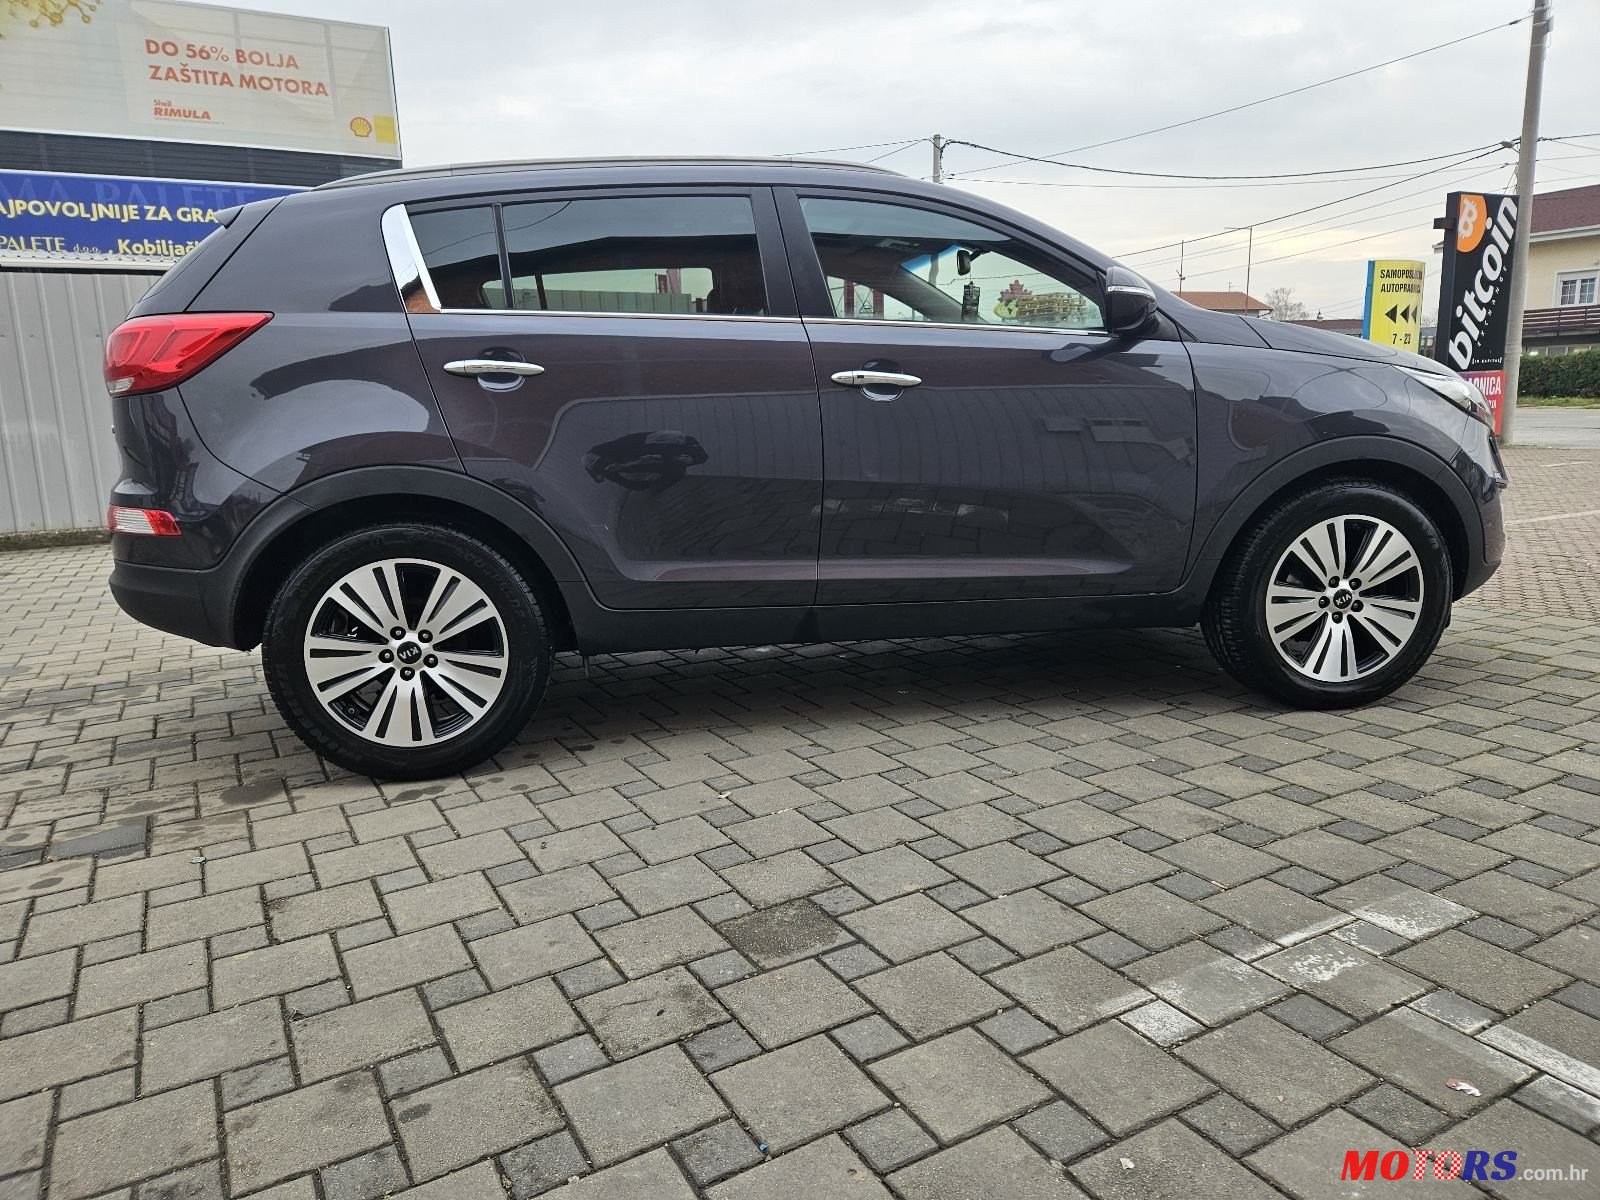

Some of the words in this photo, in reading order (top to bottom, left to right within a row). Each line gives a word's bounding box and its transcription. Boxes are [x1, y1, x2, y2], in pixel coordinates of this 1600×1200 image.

[145, 39, 178, 56] DO
[186, 44, 229, 62] 56%
[235, 49, 299, 70] BOLJA
[149, 62, 234, 87] ZAŠTITA
[239, 74, 329, 96] MOTORA
[153, 99, 172, 107] Shell
[153, 107, 211, 120] RIMULA
[144, 205, 173, 221] ZA
[1449, 197, 1518, 370] bitcoin
[1392, 333, 1398, 345] 7
[1404, 333, 1411, 345] 23
[1336, 593, 1352, 606] KIA
[399, 646, 419, 660] KIA
